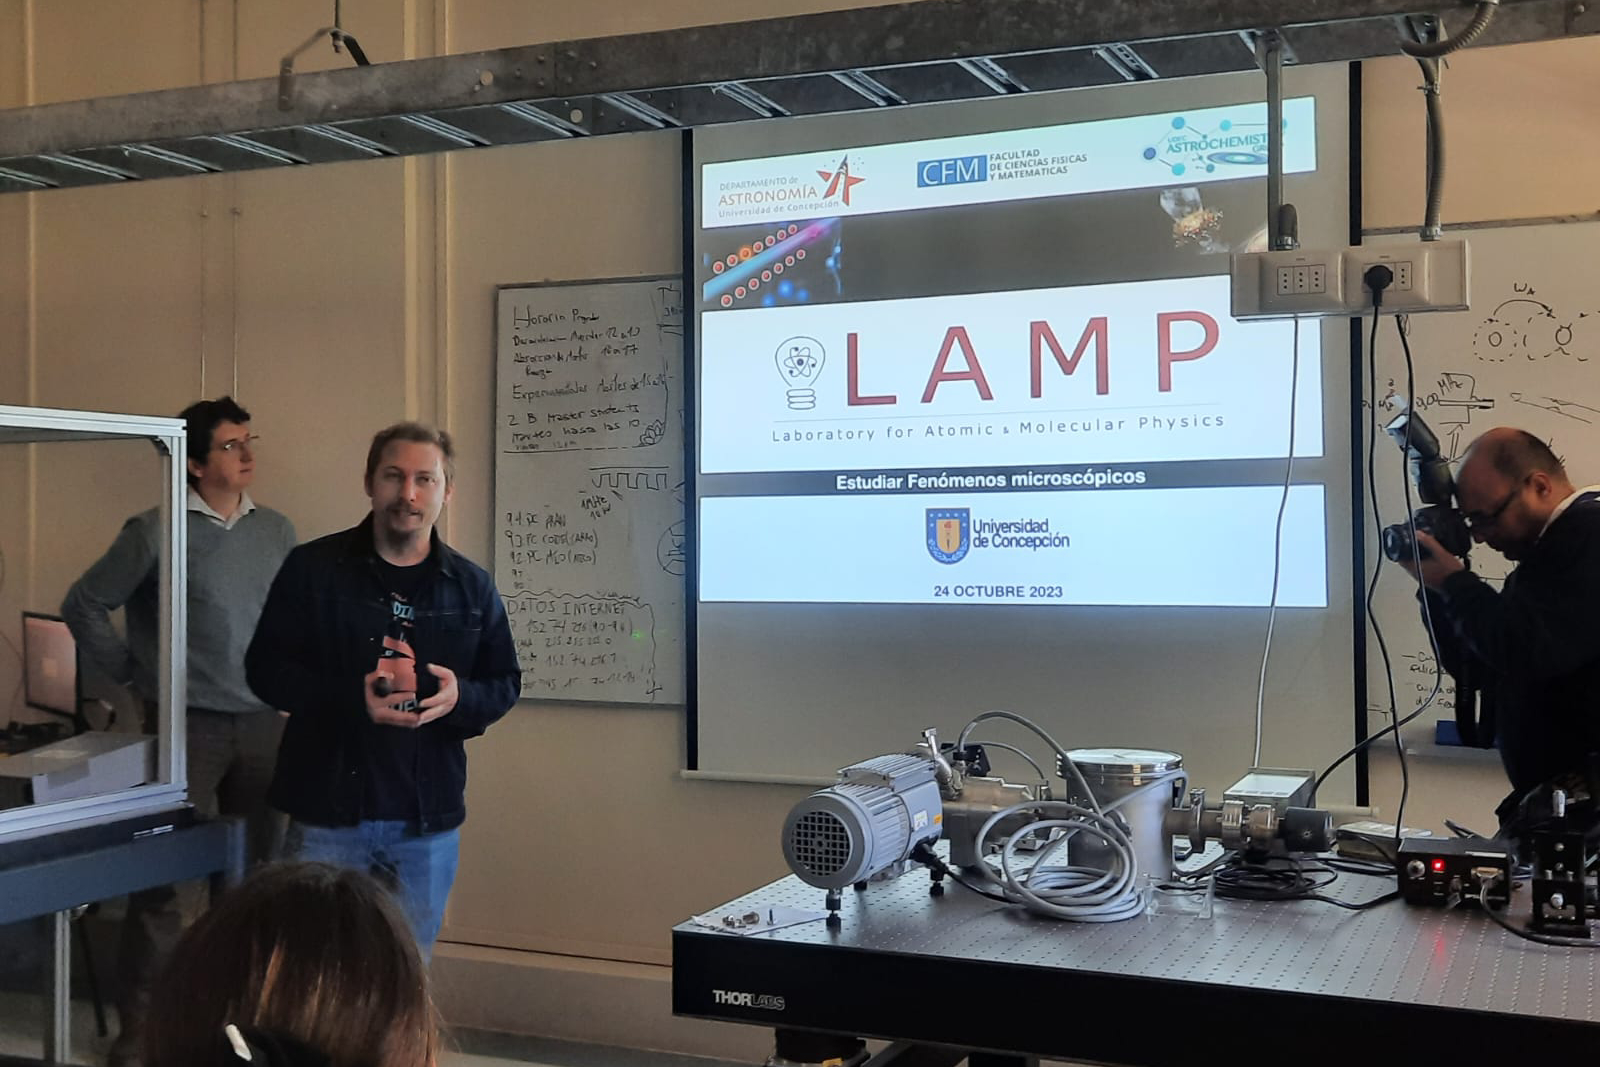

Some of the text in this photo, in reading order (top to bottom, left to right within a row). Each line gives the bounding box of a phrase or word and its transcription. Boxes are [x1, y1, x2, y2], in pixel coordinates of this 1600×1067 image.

[1166, 132, 1267, 154] ASTROCHEMIST
[989, 149, 1041, 162] FACULTAD
[989, 153, 1088, 172] DE CIENCIAS FISICAS
[921, 158, 980, 186] CFM
[989, 165, 1069, 181] Y MATEMATICAS
[719, 176, 799, 191] DEPARTAMENTO de
[718, 181, 818, 207] ASTRONOMÍA
[718, 200, 840, 218] Universidad de Concepción
[847, 310, 1220, 406] LAMP
[772, 428, 875, 442] Laboratory
[887, 425, 914, 438] for
[924, 422, 993, 438] Atomic
[1019, 418, 1125, 434] Molecular
[1139, 413, 1225, 431] Physics
[836, 468, 1147, 490] Estudiar Fenómenos microscópicos
[973, 518, 1049, 534] Universidad
[972, 531, 1070, 551] de Concepción
[934, 585, 1063, 598] 24 OCTUBRE 2023
[507, 597, 556, 615] DATOS
